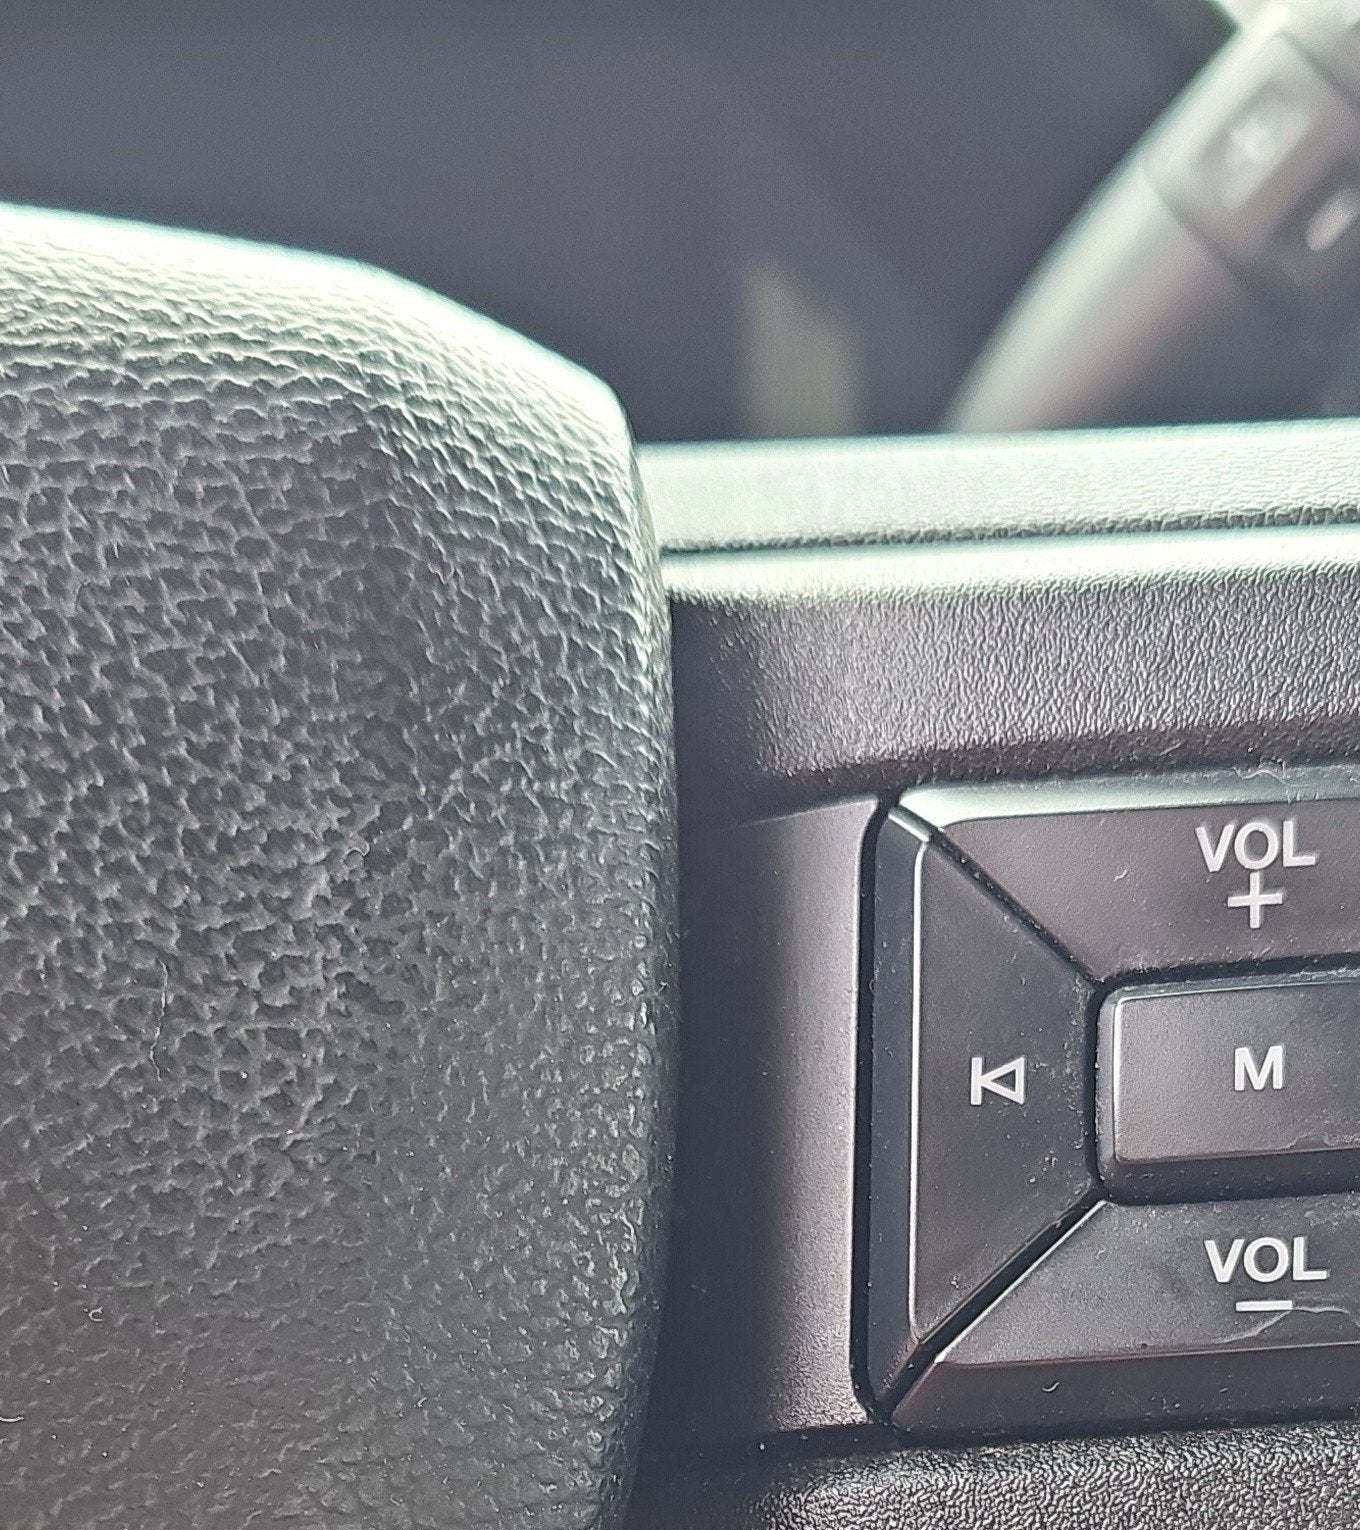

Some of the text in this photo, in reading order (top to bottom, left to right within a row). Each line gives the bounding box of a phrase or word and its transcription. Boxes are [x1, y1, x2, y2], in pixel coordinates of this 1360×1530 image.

[1195, 819, 1317, 872] VOL
[1234, 1045, 1284, 1092] M
[1204, 1236, 1329, 1283] VOL
